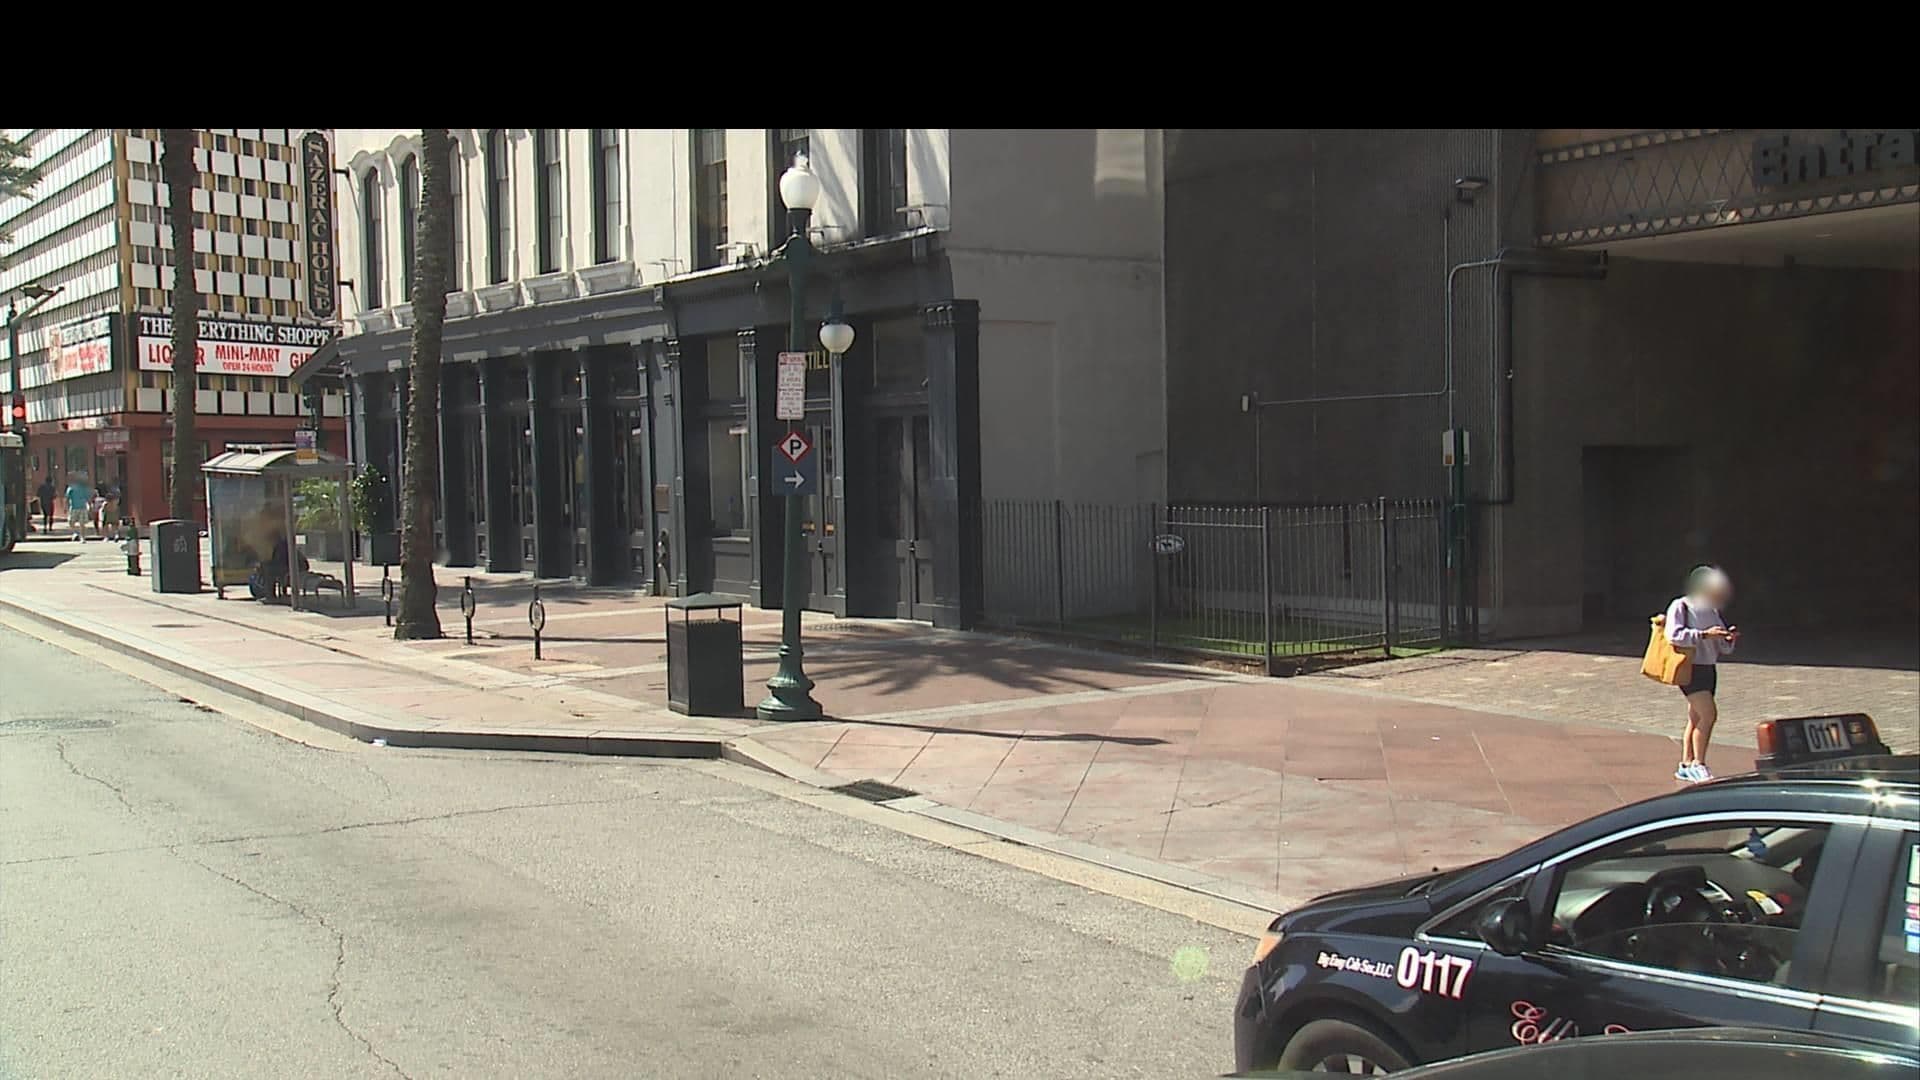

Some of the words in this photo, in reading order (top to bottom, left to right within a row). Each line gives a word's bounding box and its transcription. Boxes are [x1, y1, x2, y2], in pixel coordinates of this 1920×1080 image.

[308, 141, 328, 237] SAZERAC
[311, 241, 330, 310] HOUSE
[140, 316, 173, 336] THE
[197, 320, 274, 342] ERYTHING
[149, 343, 205, 366] LIQR
[215, 344, 281, 362] MINI-MART
[790, 439, 802, 455] P
[1808, 722, 1843, 749] 0117
[1397, 946, 1473, 1000] 0117
